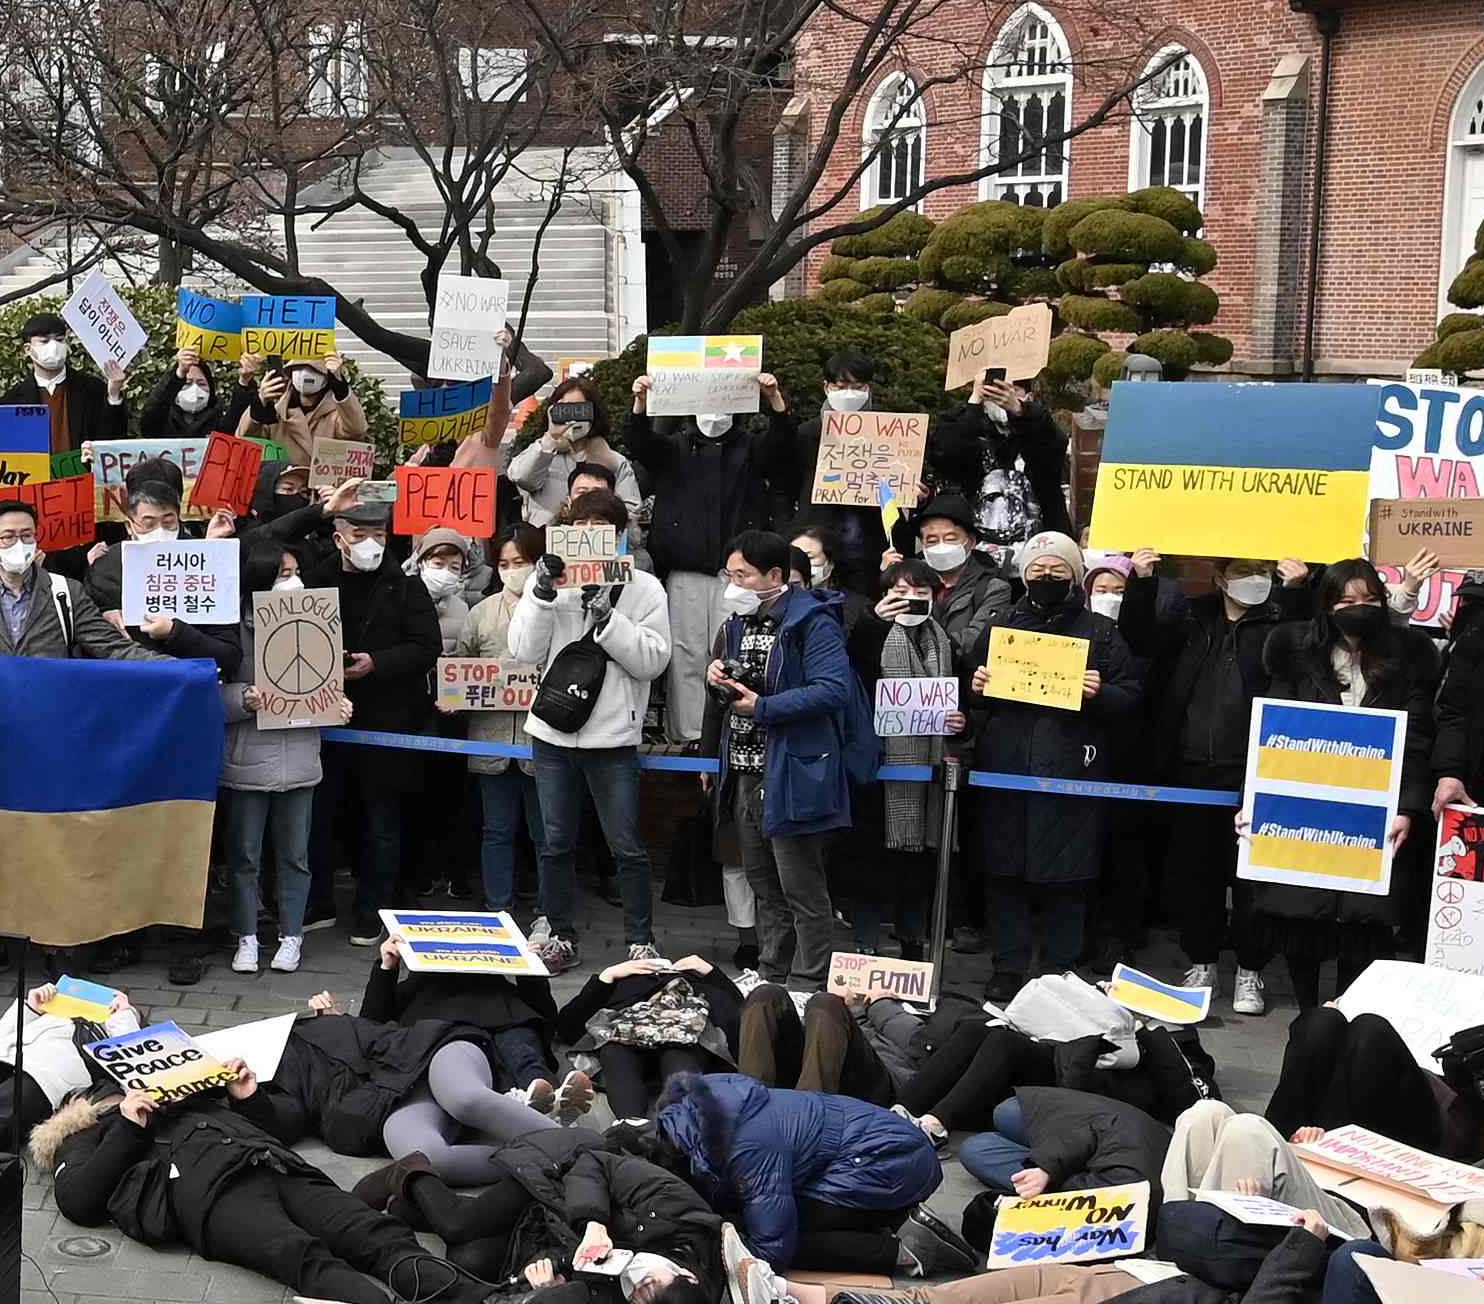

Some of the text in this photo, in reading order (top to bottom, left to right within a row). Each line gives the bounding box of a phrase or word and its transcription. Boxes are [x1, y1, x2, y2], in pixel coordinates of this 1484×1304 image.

[98, 297, 127, 336] 전쟁은
[182, 299, 216, 324] NO
[256, 299, 327, 324] НЕТ
[77, 297, 127, 362] 답이 아니다
[245, 329, 328, 356] ВОЙНЕ
[438, 330, 477, 352] SAVE
[957, 325, 1036, 363] NO WAR
[400, 406, 489, 444] ВОЙНЕ
[826, 414, 921, 438] NO WAR
[822, 442, 892, 472] 전쟁을
[344, 466, 368, 477] HELL
[1113, 468, 1329, 496] STAND WITH UKRAINE
[406, 472, 489, 524] PEACE
[814, 488, 848, 504] PRAY
[1397, 521, 1474, 538] UKRAINE
[551, 529, 615, 558] PEACE
[156, 553, 207, 571] 러시아
[145, 574, 217, 593] 침공 중단
[145, 595, 217, 613] 병력 철수
[257, 595, 342, 635] DIALOGUE
[443, 663, 500, 683] STOP
[259, 678, 344, 718] NOT WAR
[465, 685, 497, 709] 푸틴
[880, 679, 958, 708] NO WAR
[877, 710, 905, 735] YES
[1266, 733, 1386, 761] #StandWithUkraine
[1258, 822, 1377, 850] #StandWithUkraine
[833, 956, 869, 970] STOP
[868, 969, 926, 997] PUTIN
[92, 1035, 165, 1063] Give
[107, 1045, 204, 1081] Peace
[1009, 1194, 1098, 1214] Winner
[1085, 1202, 1136, 1225] NO
[1019, 1226, 1129, 1258] War has
